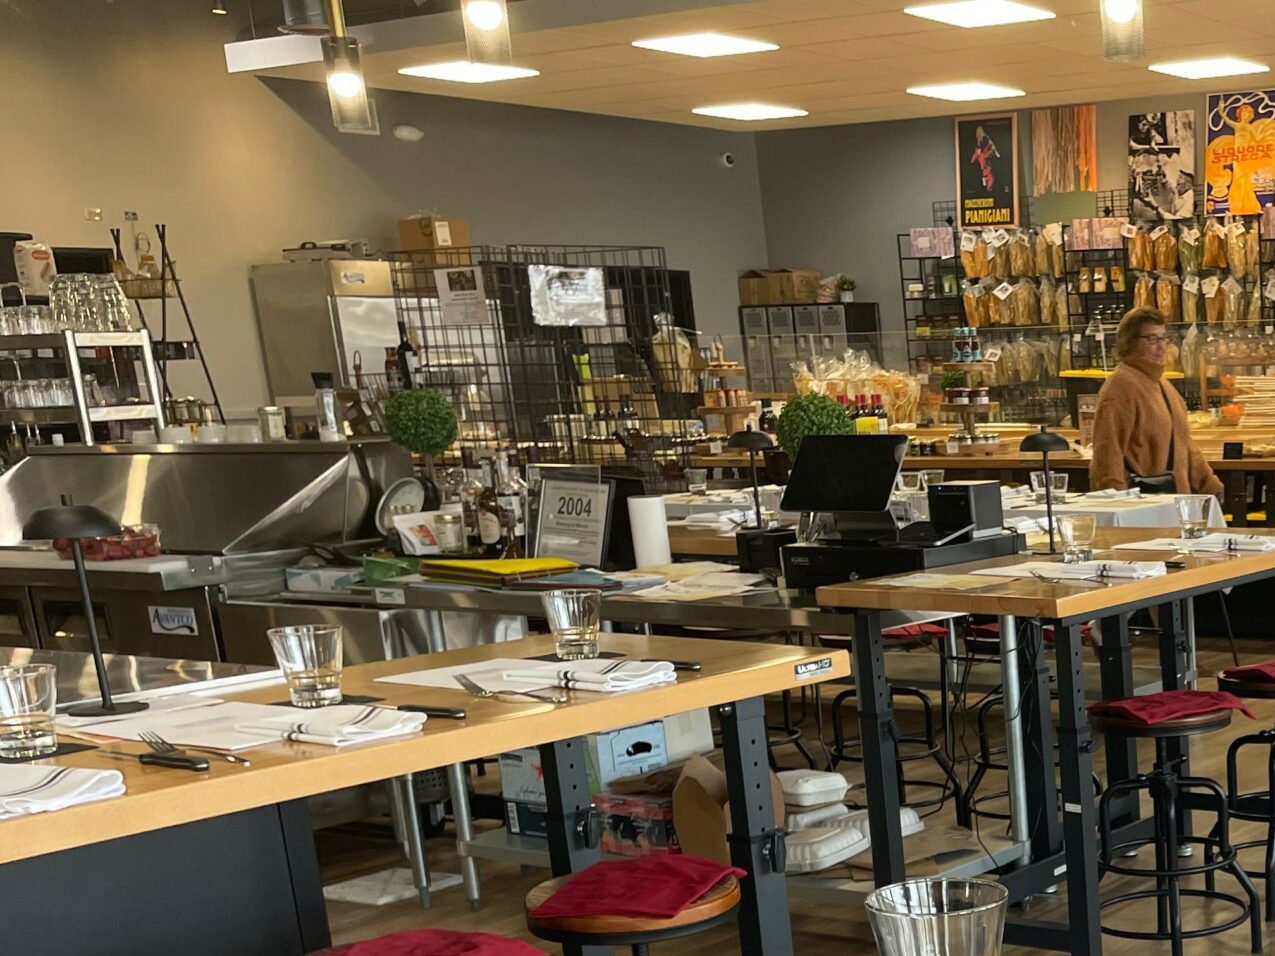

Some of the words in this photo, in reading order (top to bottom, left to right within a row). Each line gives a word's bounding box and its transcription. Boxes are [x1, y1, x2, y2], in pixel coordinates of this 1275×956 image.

[1212, 144, 1274, 156] LIQUORE
[1211, 152, 1273, 164] STREGA
[965, 207, 1010, 224] PIANIGIANI
[557, 496, 593, 518] 2004
